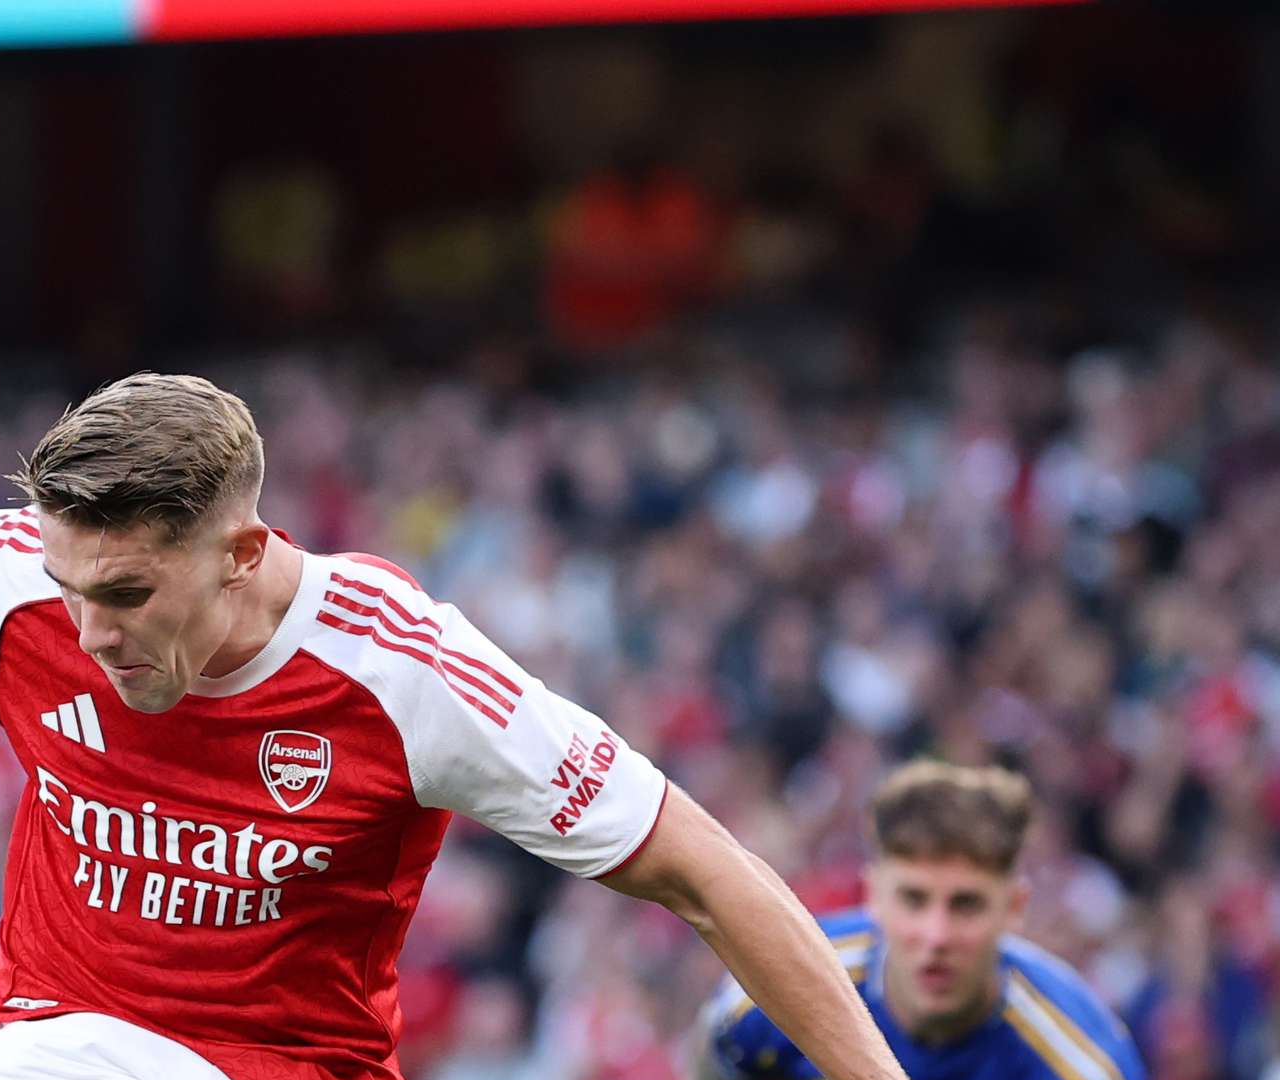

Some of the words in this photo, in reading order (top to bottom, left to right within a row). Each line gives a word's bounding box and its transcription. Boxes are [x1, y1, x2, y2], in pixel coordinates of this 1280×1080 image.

[270, 743, 321, 761] Arsenal
[550, 732, 589, 789] VISIT
[36, 765, 333, 884] Emirates
[74, 852, 129, 912] FLY
[140, 871, 282, 927] BETTER
